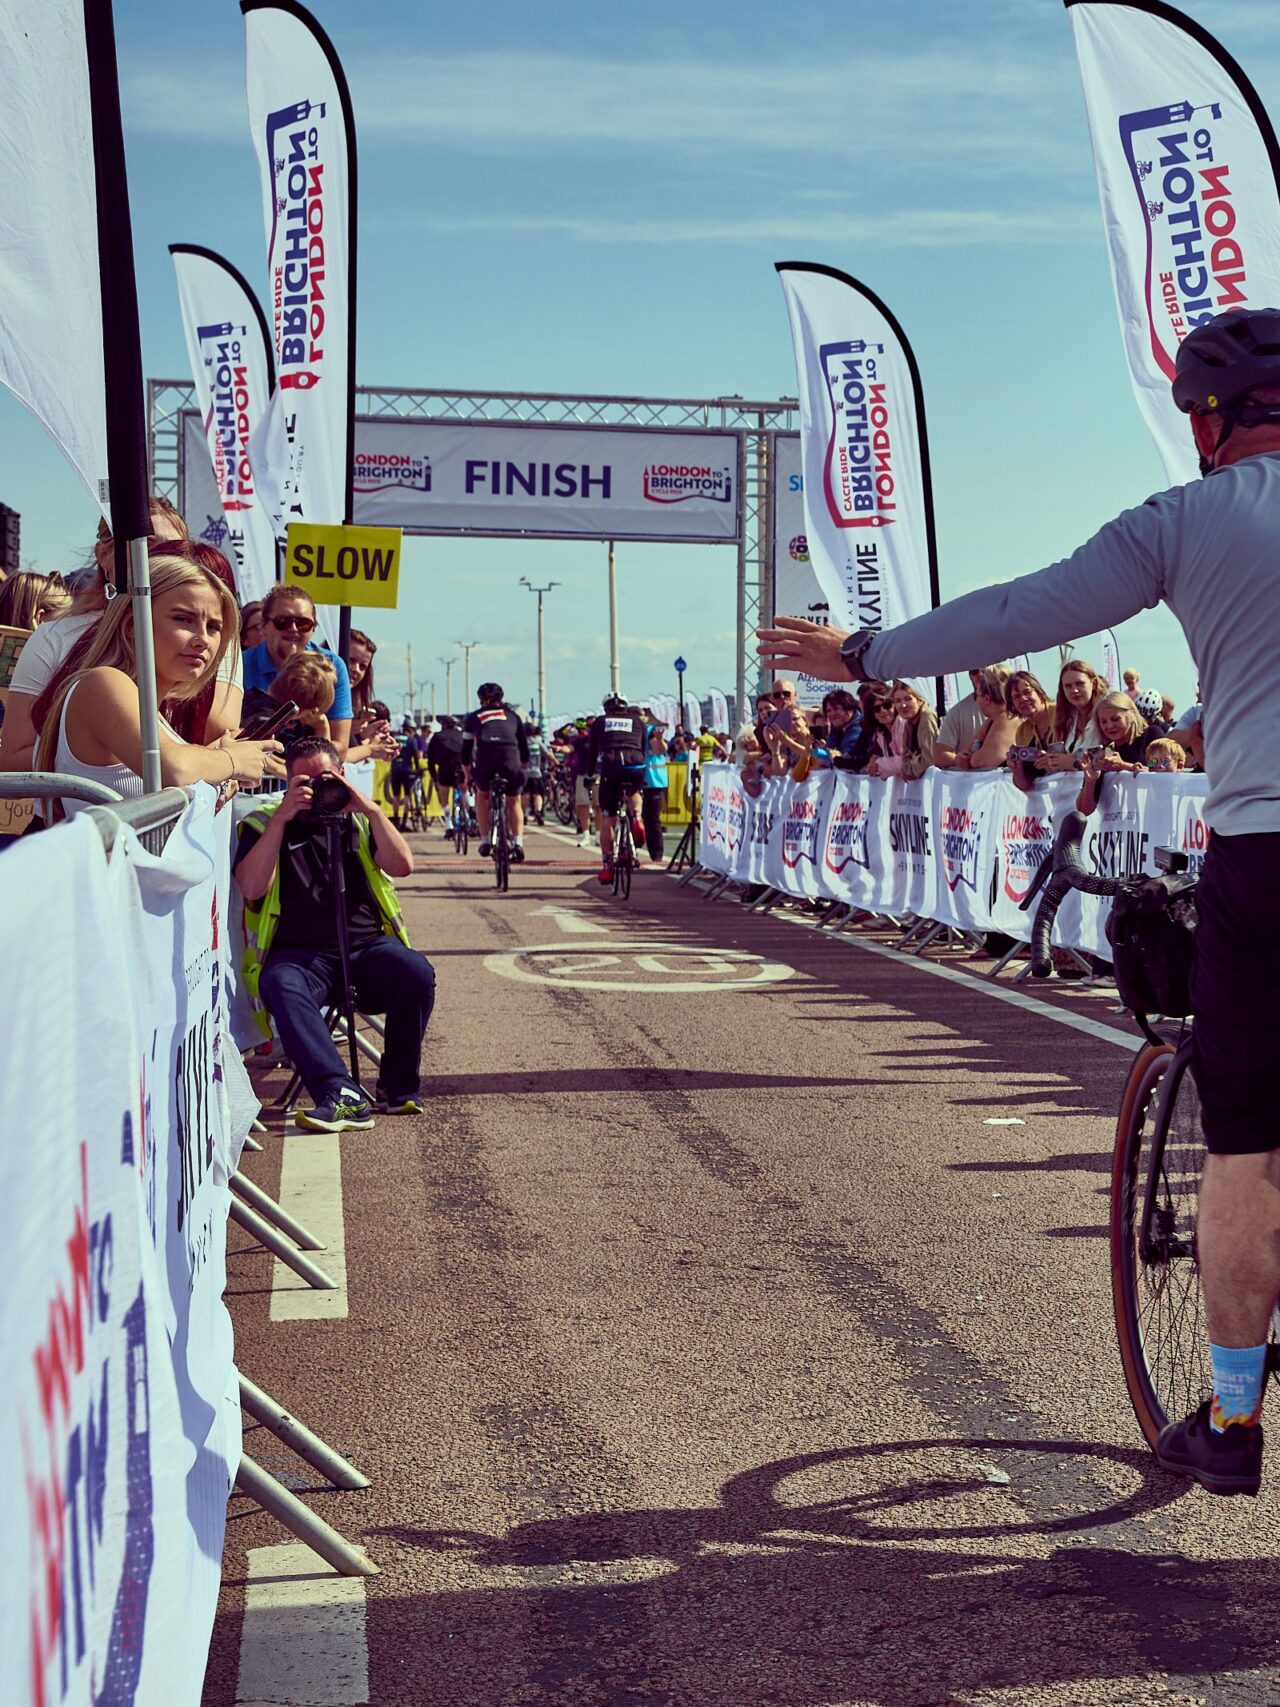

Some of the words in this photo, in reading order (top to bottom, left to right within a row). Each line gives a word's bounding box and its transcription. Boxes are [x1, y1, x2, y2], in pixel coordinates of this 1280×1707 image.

[354, 454, 410, 466] ONDON
[651, 464, 710, 477] LONDON
[465, 460, 611, 498] FINISH
[651, 477, 722, 489] BRIGHTON
[292, 544, 394, 581] SLOW
[890, 813, 932, 856] SKYLINE
